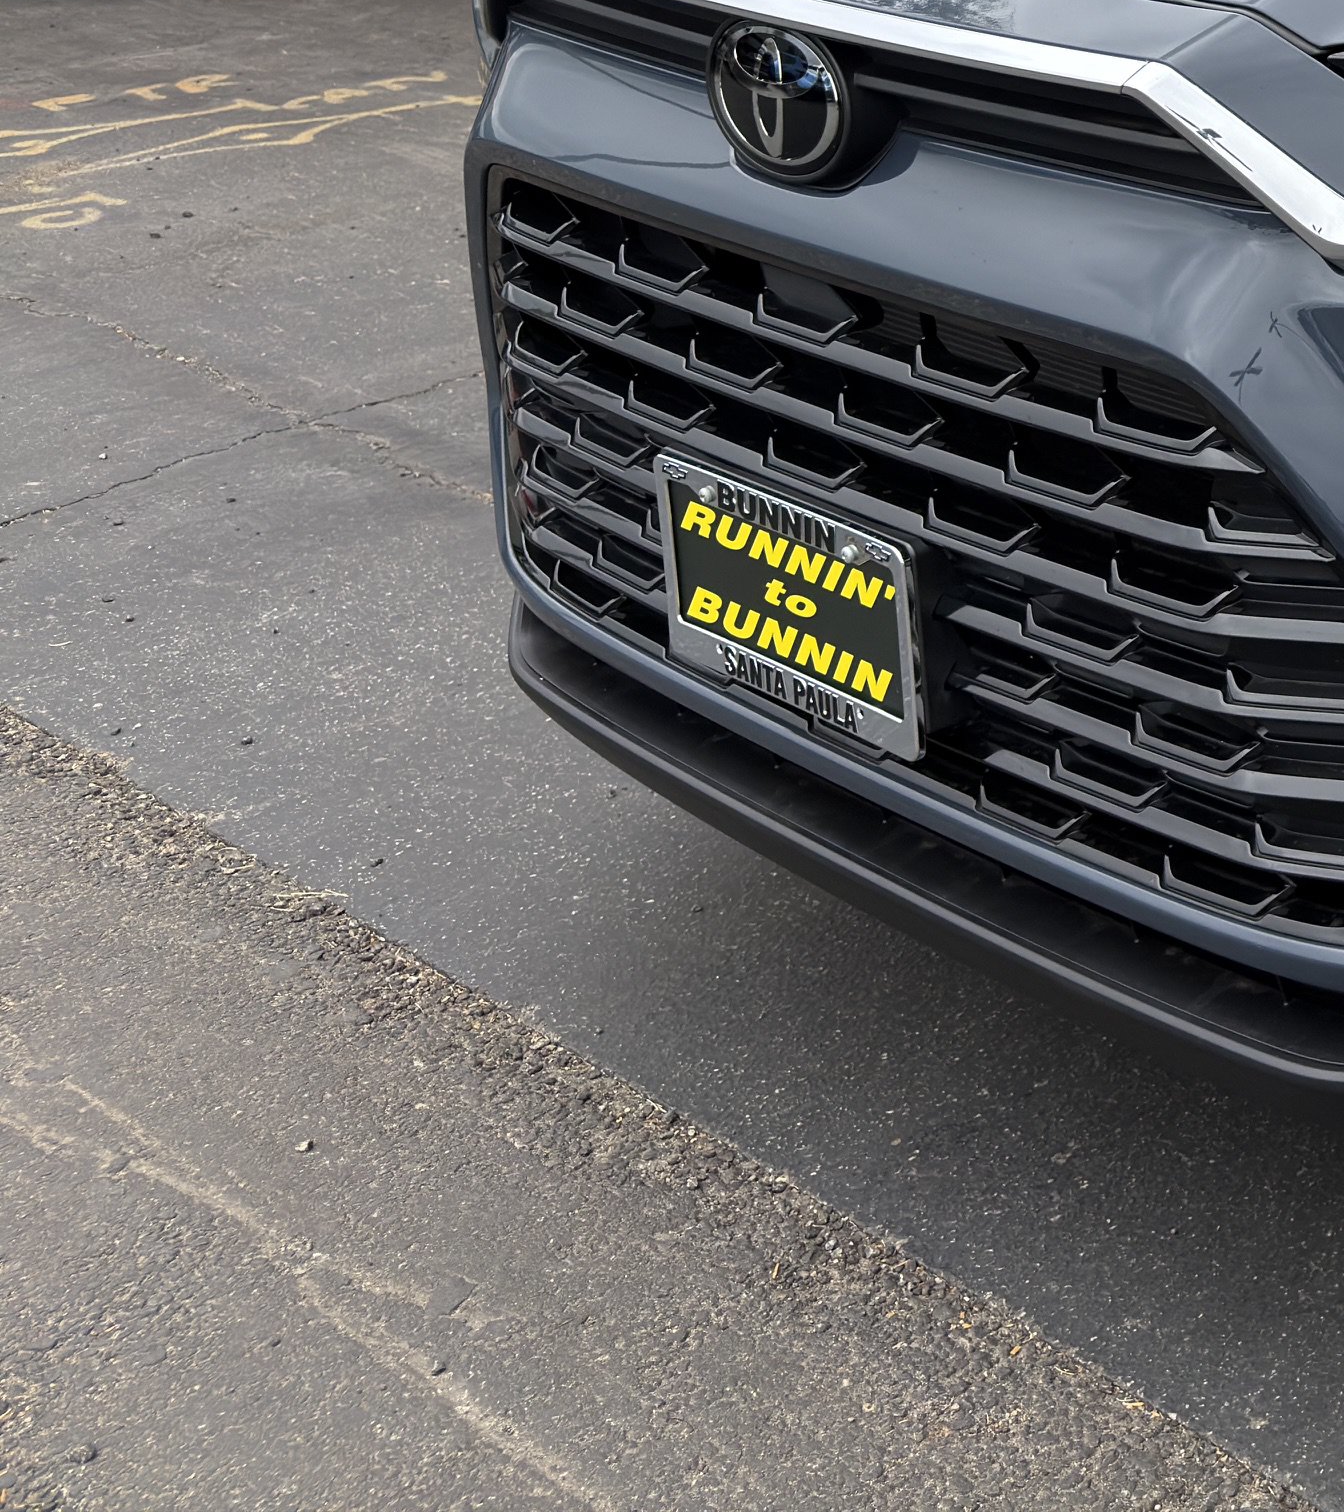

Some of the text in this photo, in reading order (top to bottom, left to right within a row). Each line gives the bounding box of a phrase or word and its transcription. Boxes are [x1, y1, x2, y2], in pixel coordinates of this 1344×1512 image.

[680, 501, 896, 608] RUNNIN'
[717, 479, 836, 553] BUNNIN
[764, 578, 817, 617] to
[687, 586, 894, 702] BUNNIN
[723, 645, 860, 733] SANTA PAULA
